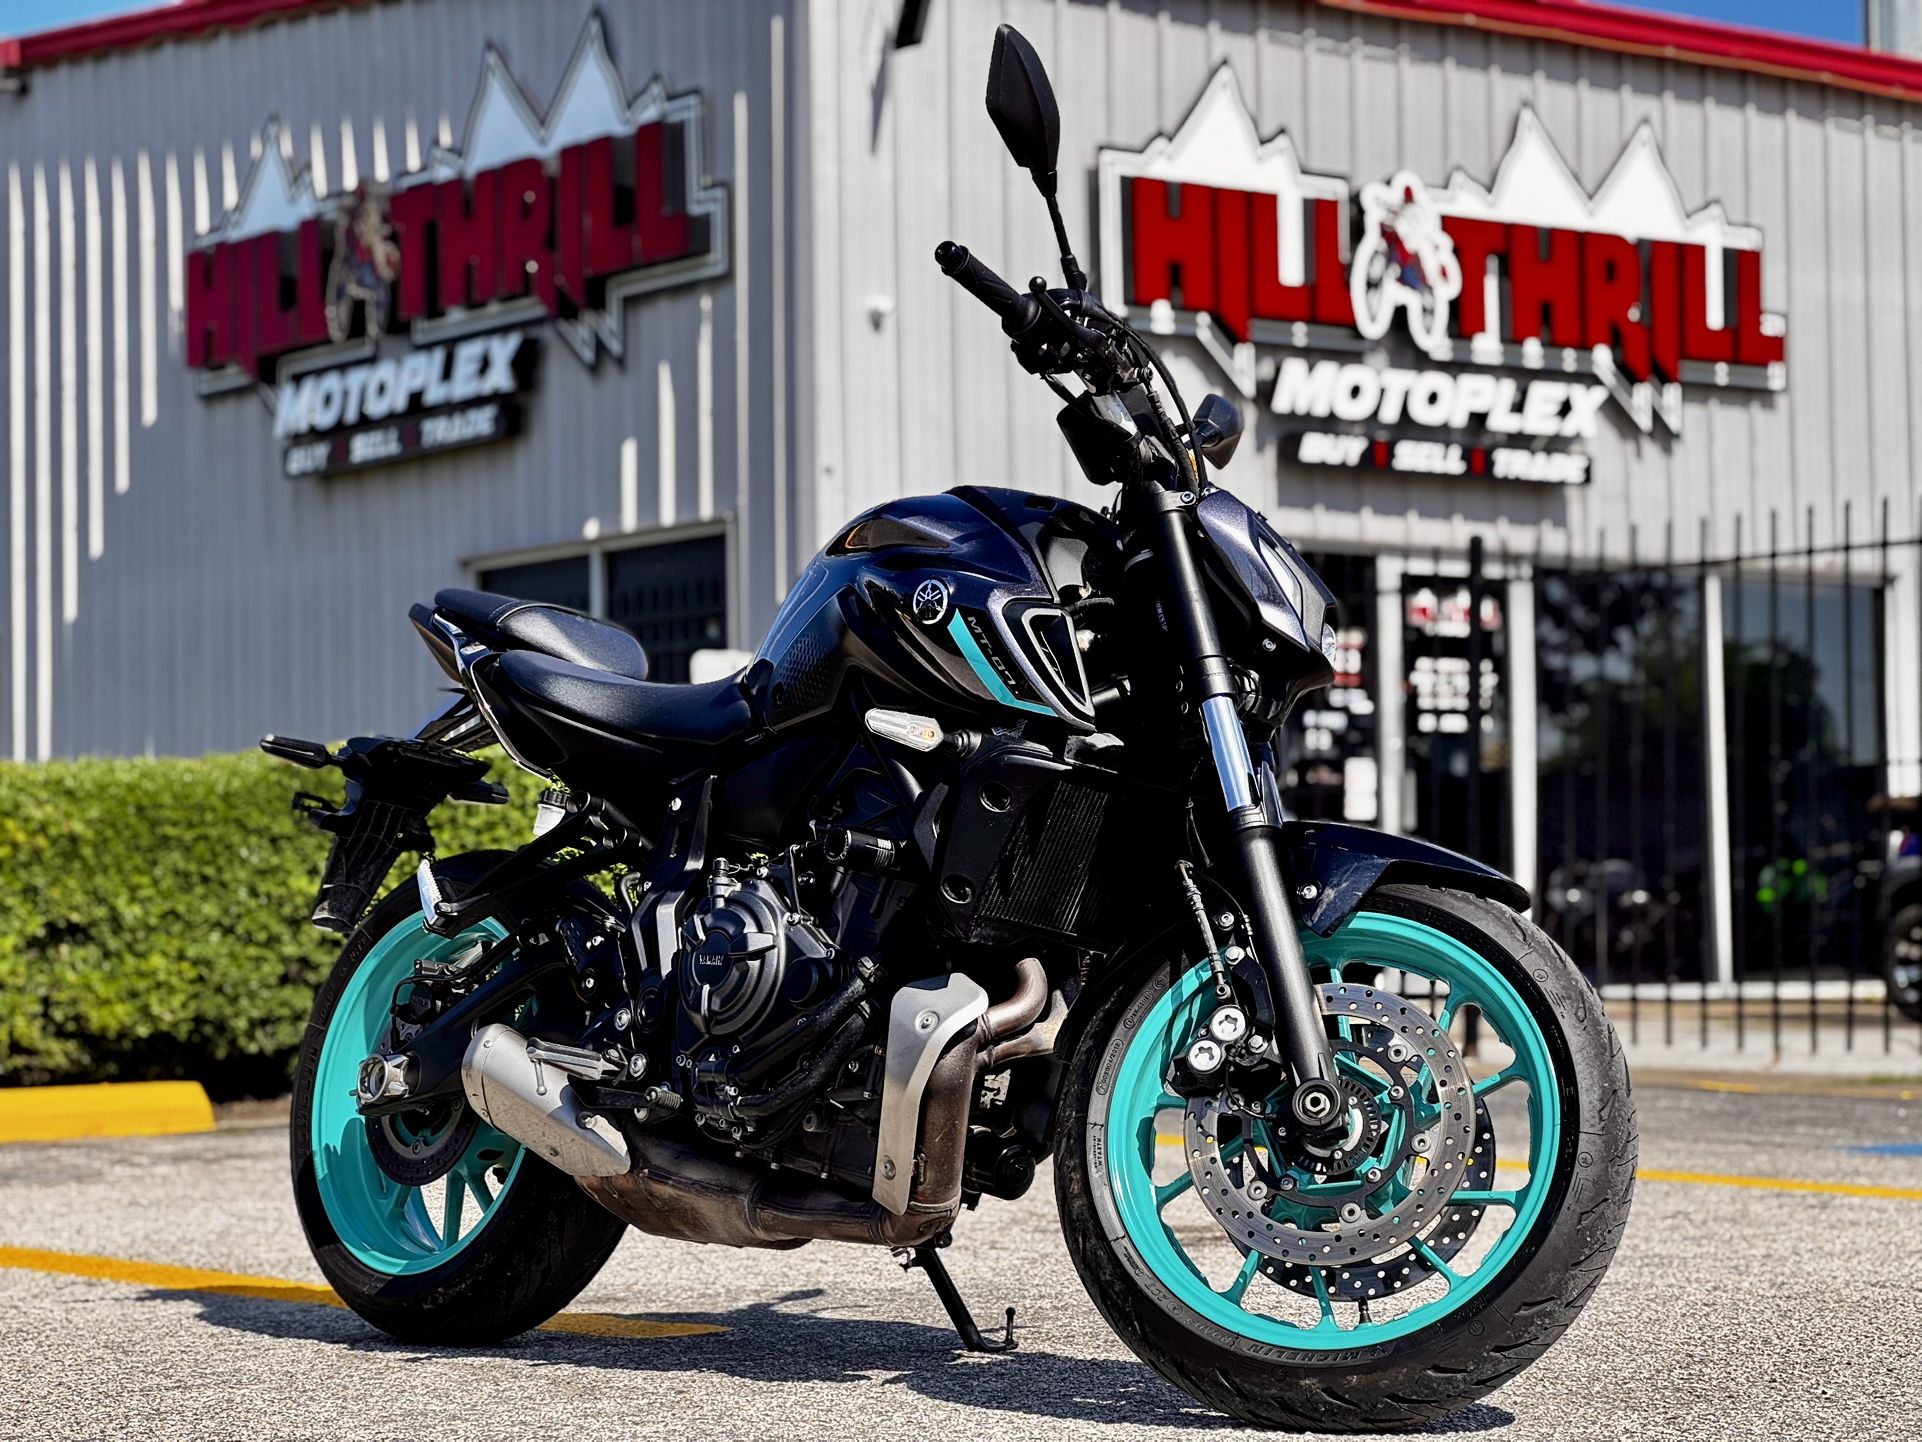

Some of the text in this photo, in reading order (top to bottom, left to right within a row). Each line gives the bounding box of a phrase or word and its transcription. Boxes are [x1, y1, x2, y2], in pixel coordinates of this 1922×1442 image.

[187, 121, 689, 379] HILL THRILL
[1132, 177, 1784, 382] HILL THRILL
[274, 333, 525, 439] MOTOPLEX
[1272, 358, 1609, 438] MOTOPLEX
[286, 405, 498, 475] BUY SELL TRADE
[1300, 431, 1589, 484] BUY SELL TRADE
[967, 616, 1017, 685] MT-07
[1246, 1343, 1361, 1362] MICHELIN
